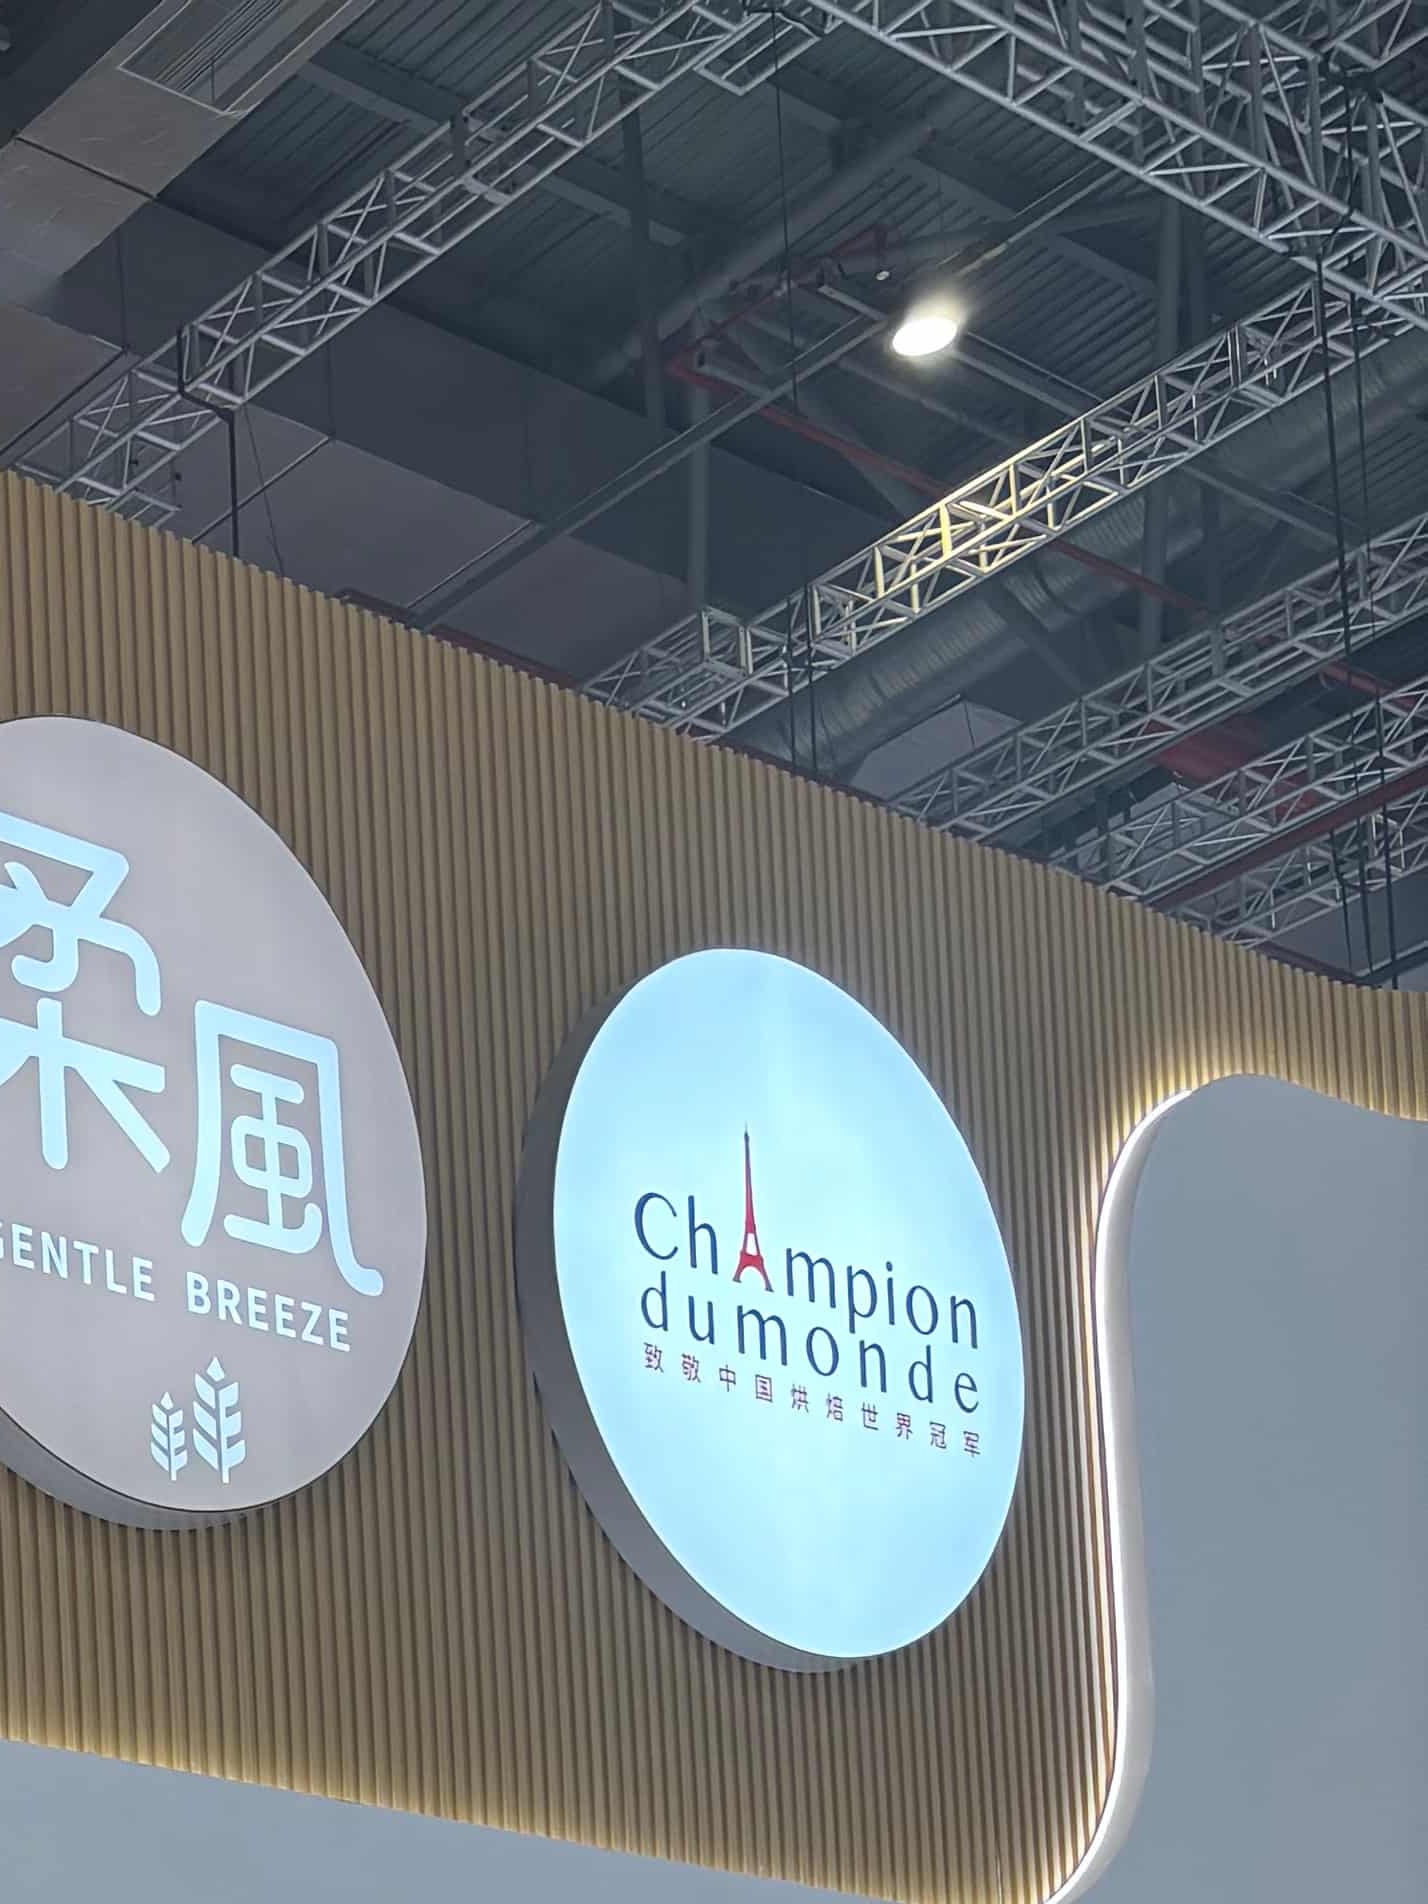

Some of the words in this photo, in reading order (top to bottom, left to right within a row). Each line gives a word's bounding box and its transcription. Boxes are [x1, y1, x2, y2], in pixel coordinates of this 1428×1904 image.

[185, 1270, 352, 1353] BREEZE
[643, 1342, 981, 1457] 致敬中国烘焙世界冠军
